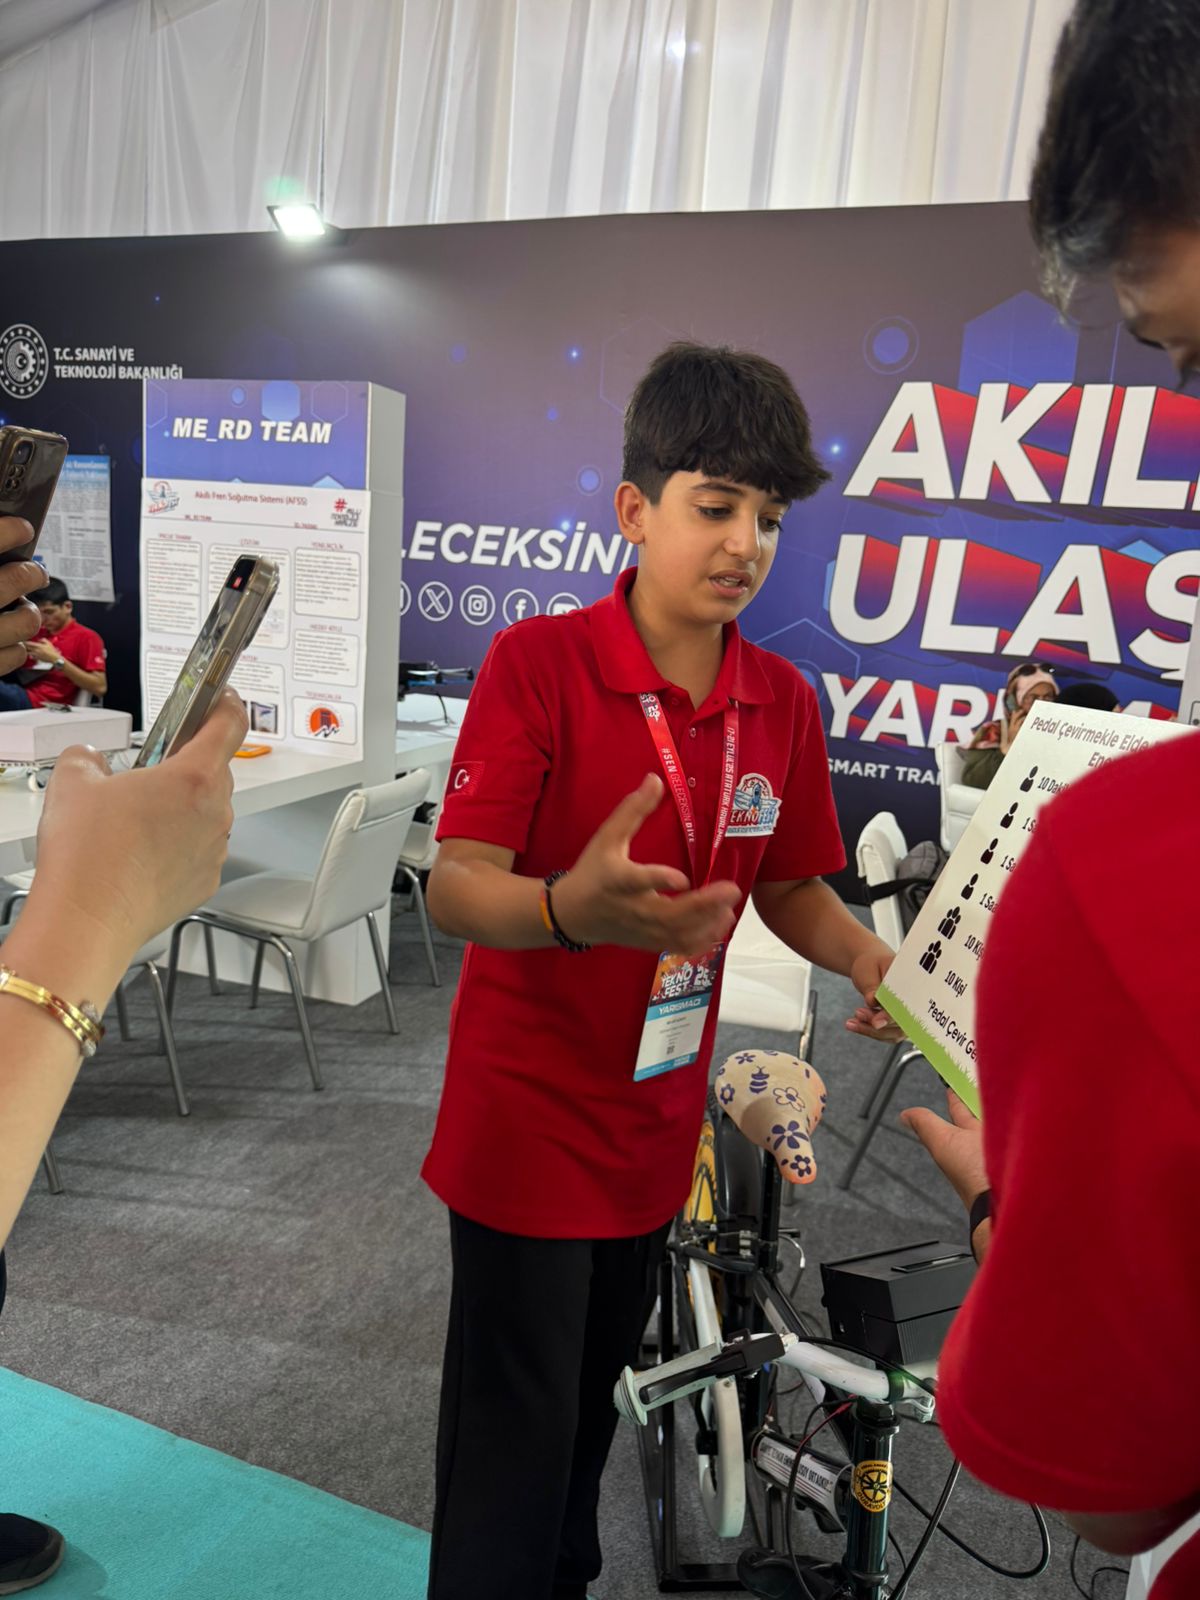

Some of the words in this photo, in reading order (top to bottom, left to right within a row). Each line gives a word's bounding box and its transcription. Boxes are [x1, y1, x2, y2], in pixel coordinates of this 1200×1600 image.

[53, 347, 74, 360] T.C.
[75, 345, 117, 361] SANAYİ
[118, 348, 134, 361] VE
[54, 363, 116, 379] TEKNOLOJİ
[118, 363, 183, 379] BAKANLIĞI
[172, 417, 252, 442] ME_RD
[260, 420, 332, 444] TEAM
[843, 381, 1200, 511] AKIL
[402, 520, 634, 575] ECEKSİN
[1030, 716, 1061, 735] Pedal
[1059, 722, 1118, 749] Çevirmekle
[1119, 734, 1149, 752] Elde
[827, 757, 889, 780] SMART
[1037, 776, 1050, 790] 10
[964, 934, 976, 950] 10
[944, 970, 956, 985] 10
[951, 978, 968, 997] Kişi
[945, 1020, 968, 1047] Çevir
